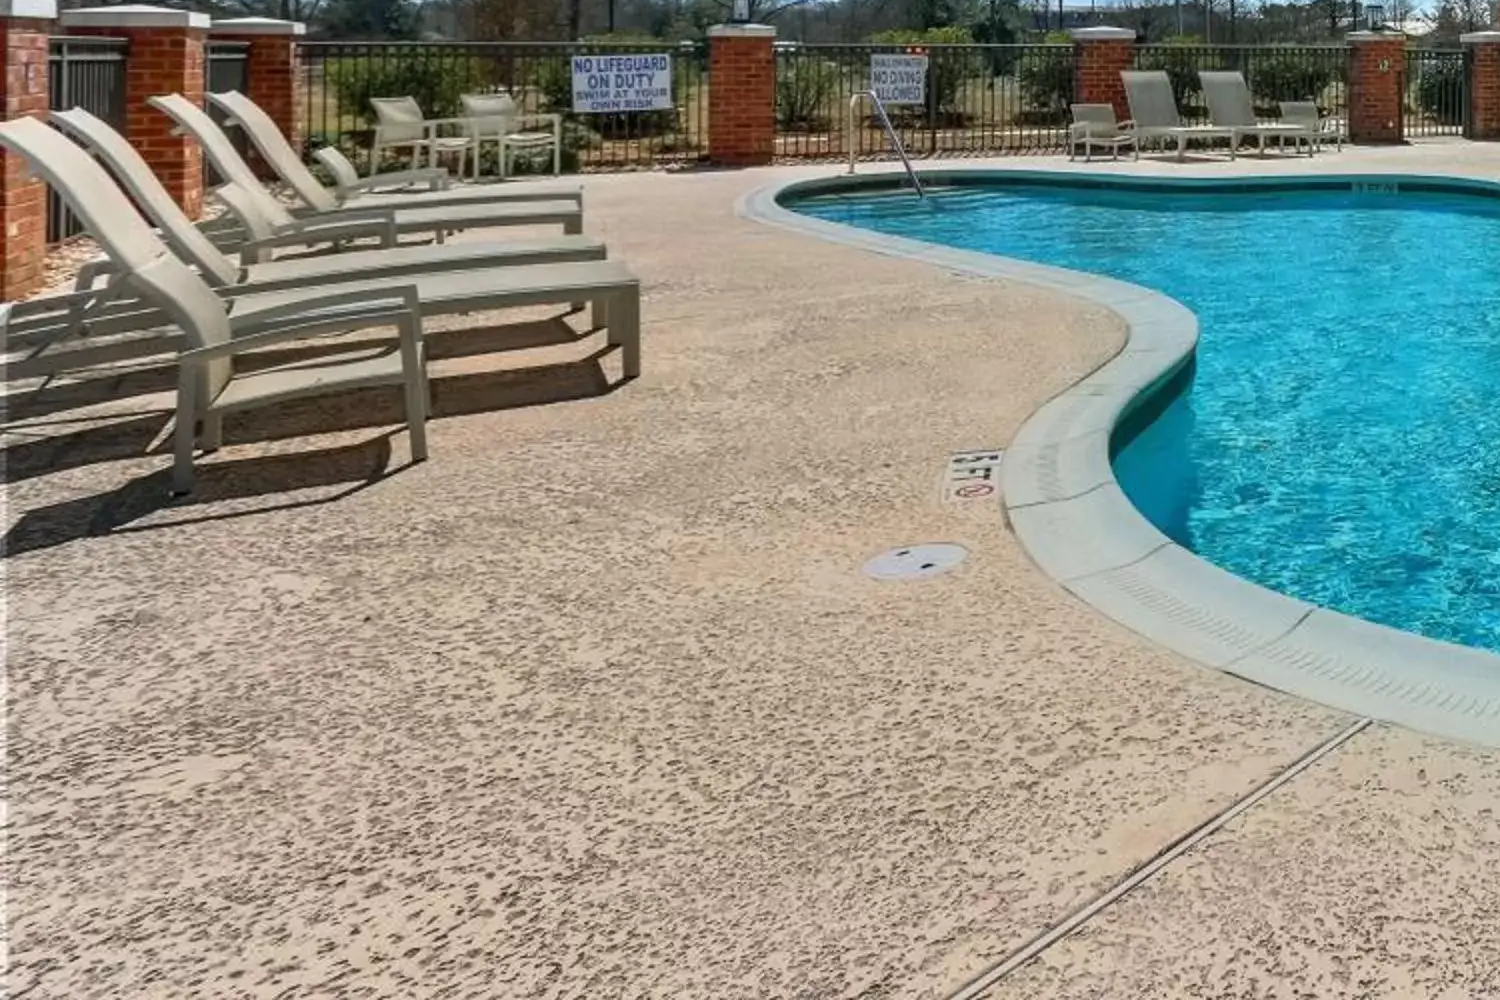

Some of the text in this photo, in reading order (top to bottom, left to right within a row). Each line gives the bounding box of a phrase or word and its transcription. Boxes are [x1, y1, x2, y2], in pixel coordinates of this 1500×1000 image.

[575, 57, 667, 73] NO LIFEGUARD
[587, 73, 654, 89] ON DUTY
[873, 70, 921, 84] NO DIVING
[575, 90, 610, 101] SWIM
[613, 89, 629, 99] AT
[875, 87, 920, 101] ALLOWED
